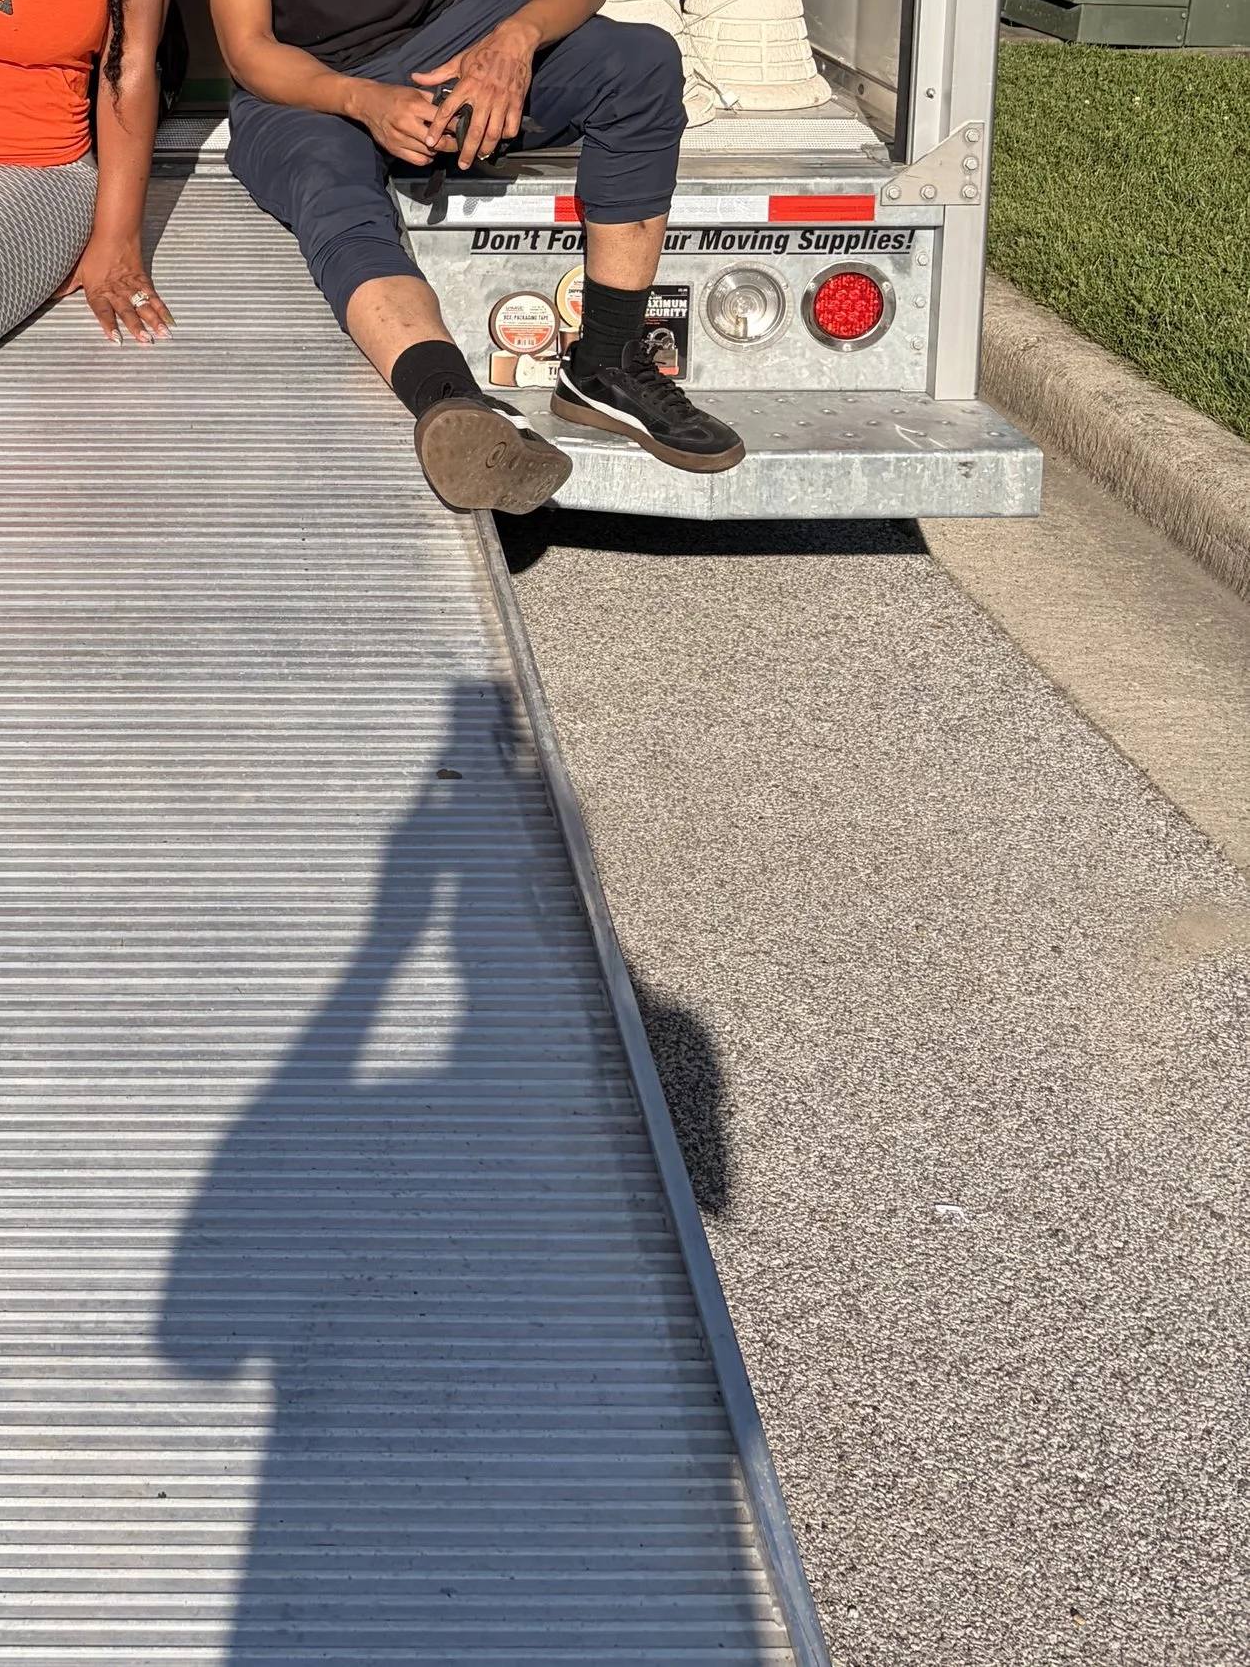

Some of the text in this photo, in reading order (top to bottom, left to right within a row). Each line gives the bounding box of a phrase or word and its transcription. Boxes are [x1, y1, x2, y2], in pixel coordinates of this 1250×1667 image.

[471, 227, 539, 251] Don't
[698, 229, 790, 255] Moving
[797, 228, 916, 255] Supplies!
